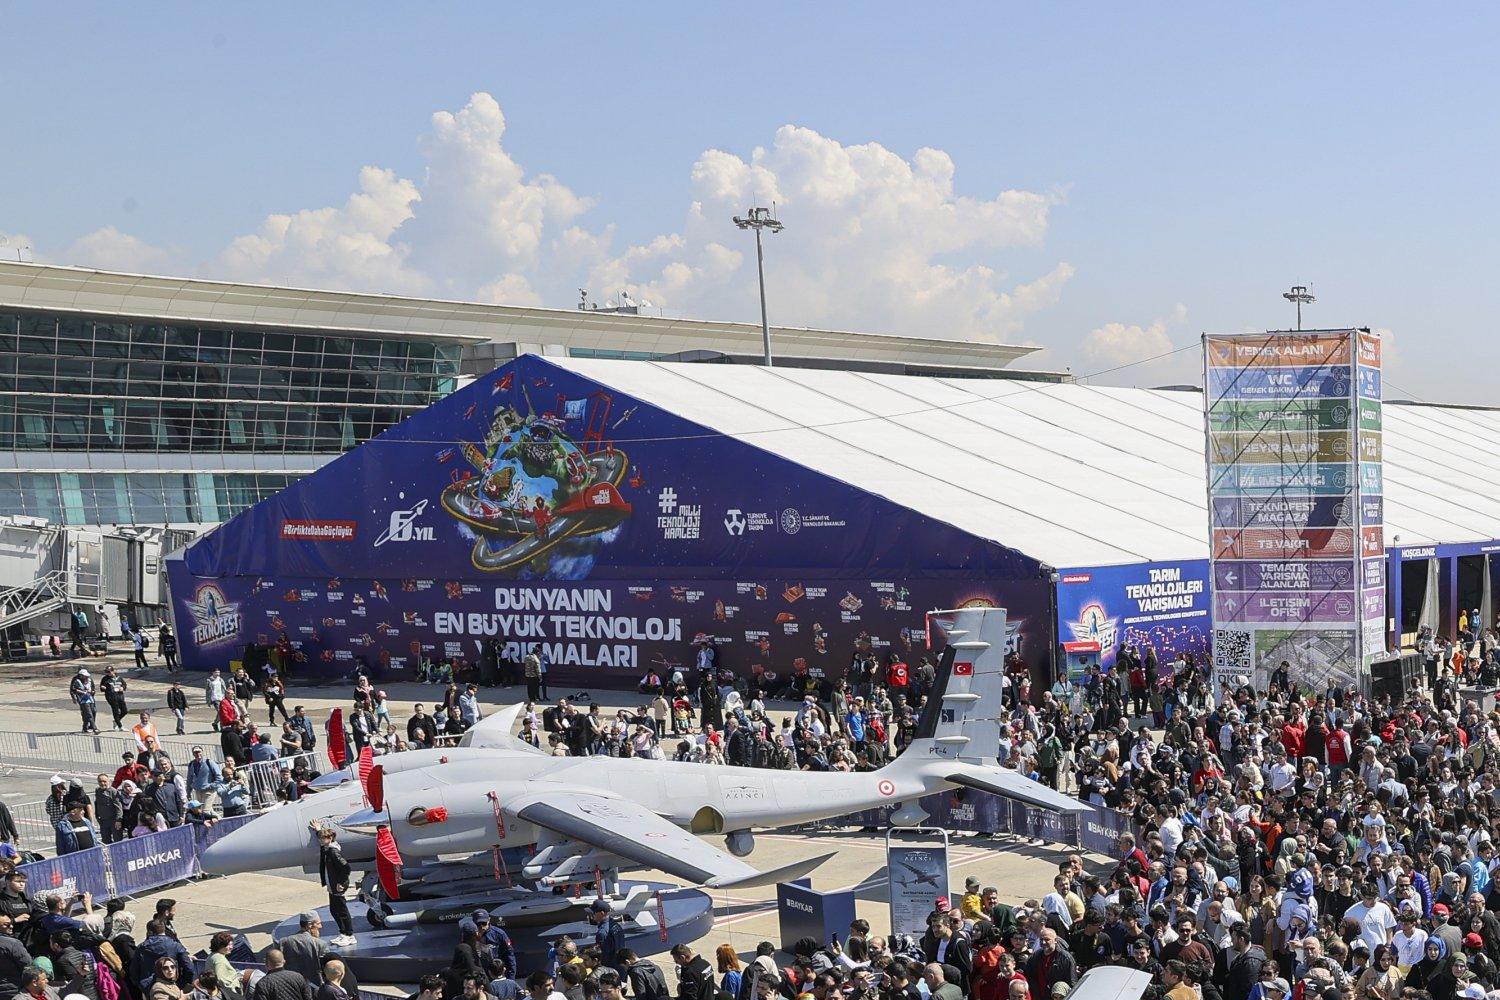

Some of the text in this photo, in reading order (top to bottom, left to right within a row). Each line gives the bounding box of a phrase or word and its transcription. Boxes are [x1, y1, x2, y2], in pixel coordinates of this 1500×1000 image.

[1236, 344, 1324, 357] YEMEK ALANI
[1267, 374, 1292, 385] WC
[1149, 567, 1181, 583] TARIM
[1260, 580, 1310, 588] ALANLARI
[1138, 595, 1193, 612] YARIŞMASI
[192, 613, 241, 644] TEKNOFEST
[434, 611, 682, 642] EN BÜYÜK TEKNOLOJİ
[136, 848, 182, 870] BAYKAR
[790, 899, 814, 914] BAYKAR
